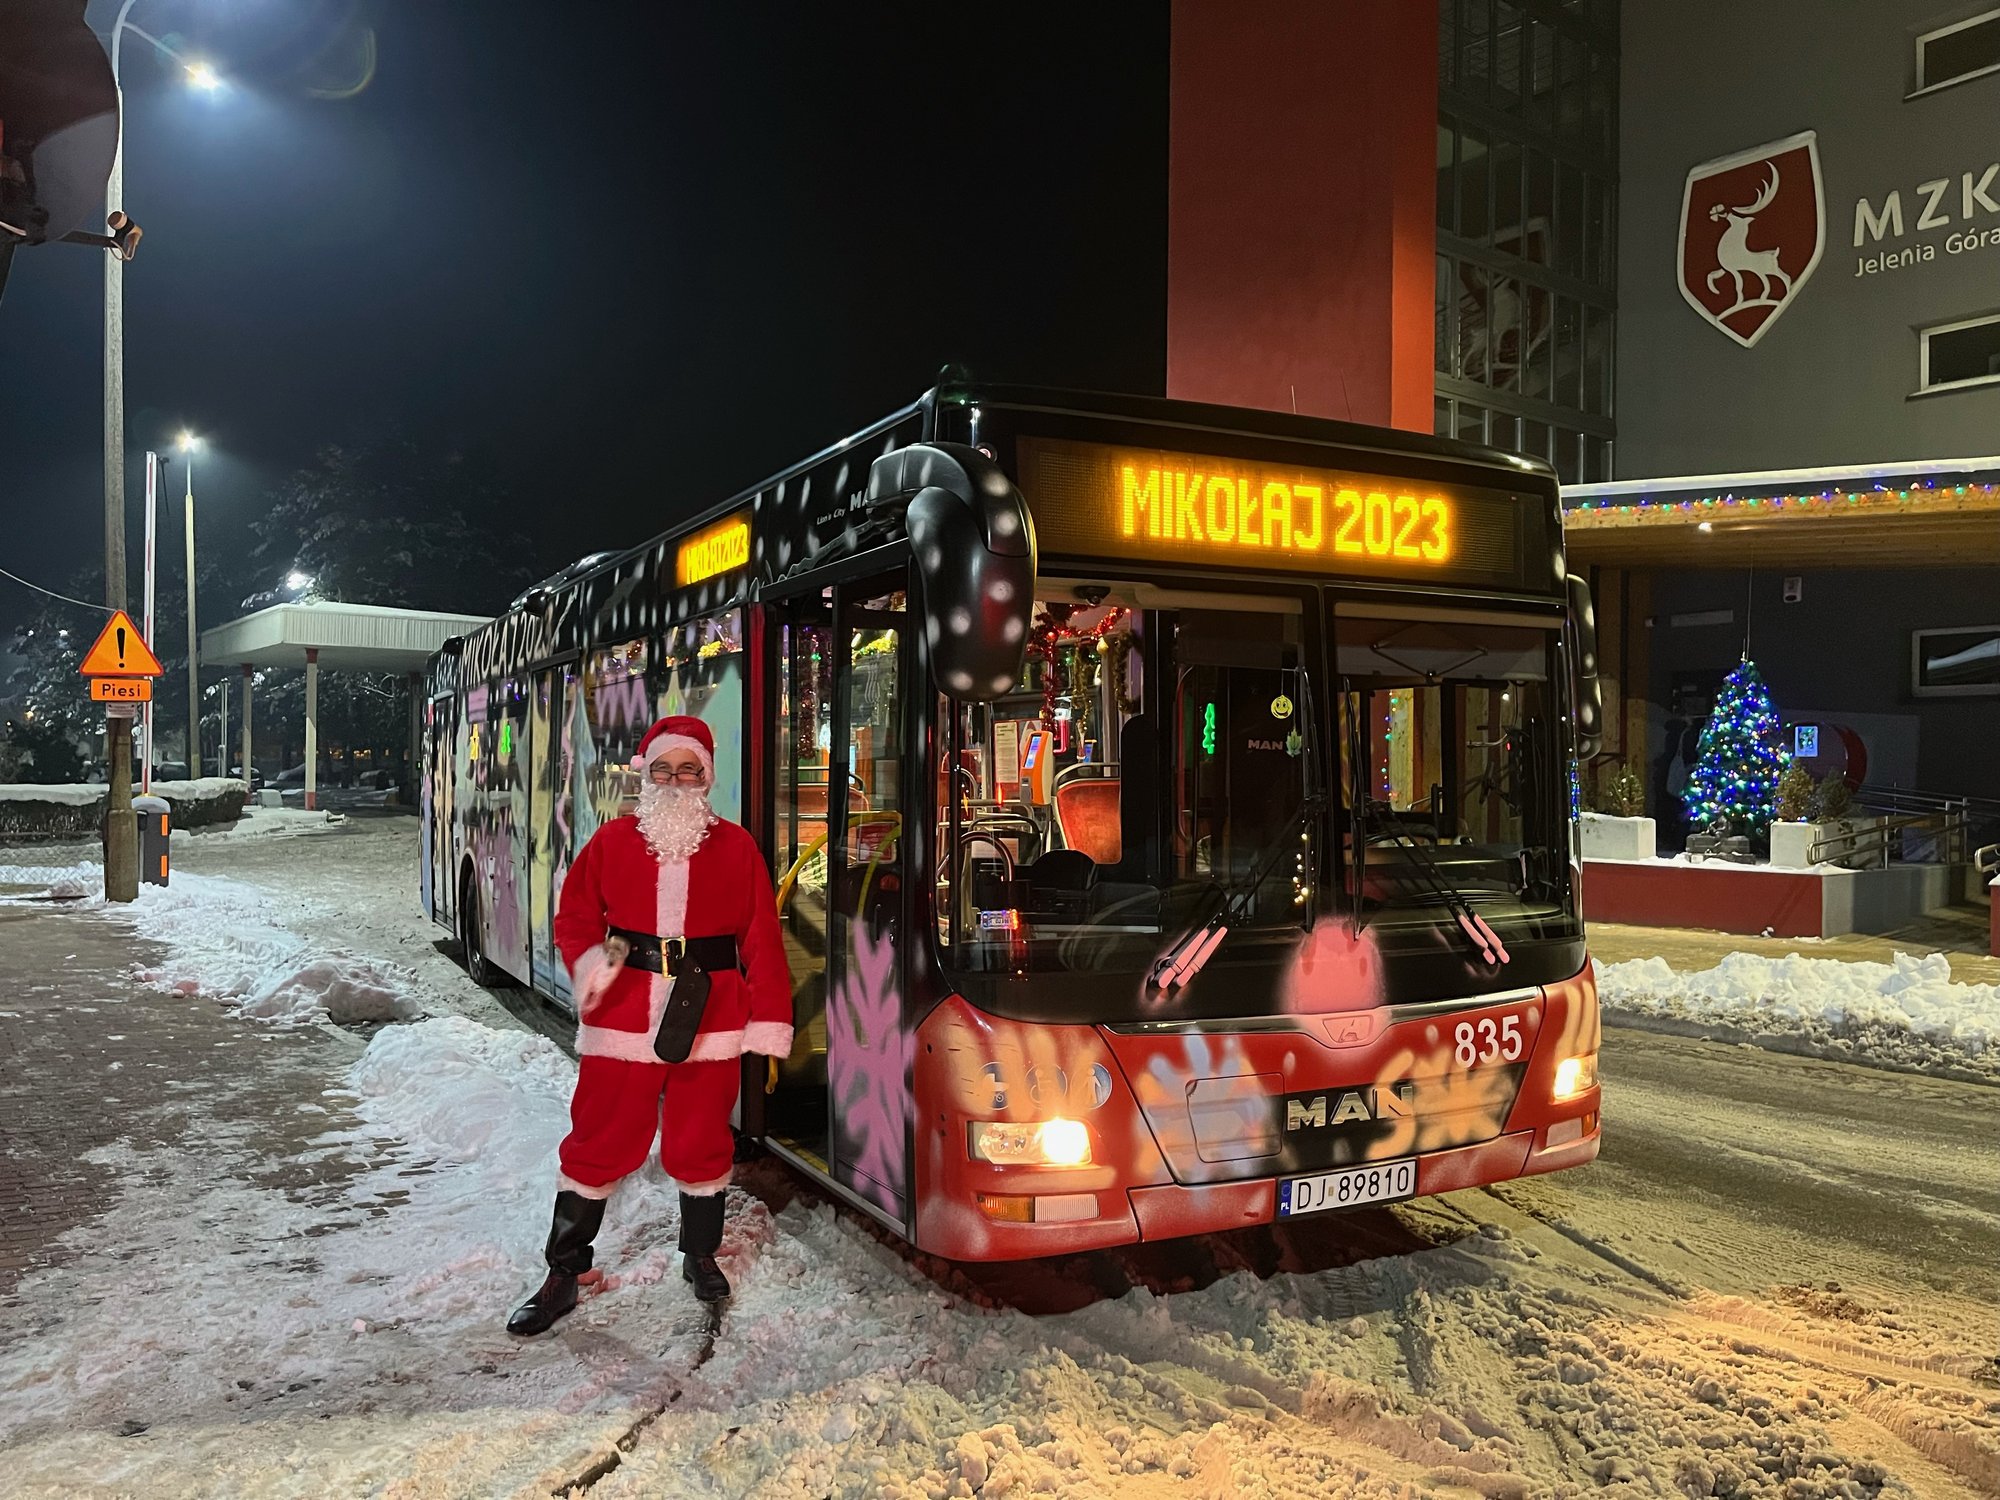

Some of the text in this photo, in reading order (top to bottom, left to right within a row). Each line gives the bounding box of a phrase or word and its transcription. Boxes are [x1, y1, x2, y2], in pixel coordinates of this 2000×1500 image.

[1853, 162, 2000, 247] MZK
[1854, 227, 2000, 277] Jelenia Góra
[1122, 466, 1449, 561] MIKOŁAJ 2023
[460, 614, 518, 690] MIKOŁAJ
[102, 683, 141, 697] Piesi
[1248, 739, 1283, 750] MAN
[1454, 1014, 1522, 1068] 835
[1287, 1083, 1413, 1131] MAN
[1280, 1202, 1290, 1211] PL
[1297, 1165, 1409, 1210] DJ 89810
